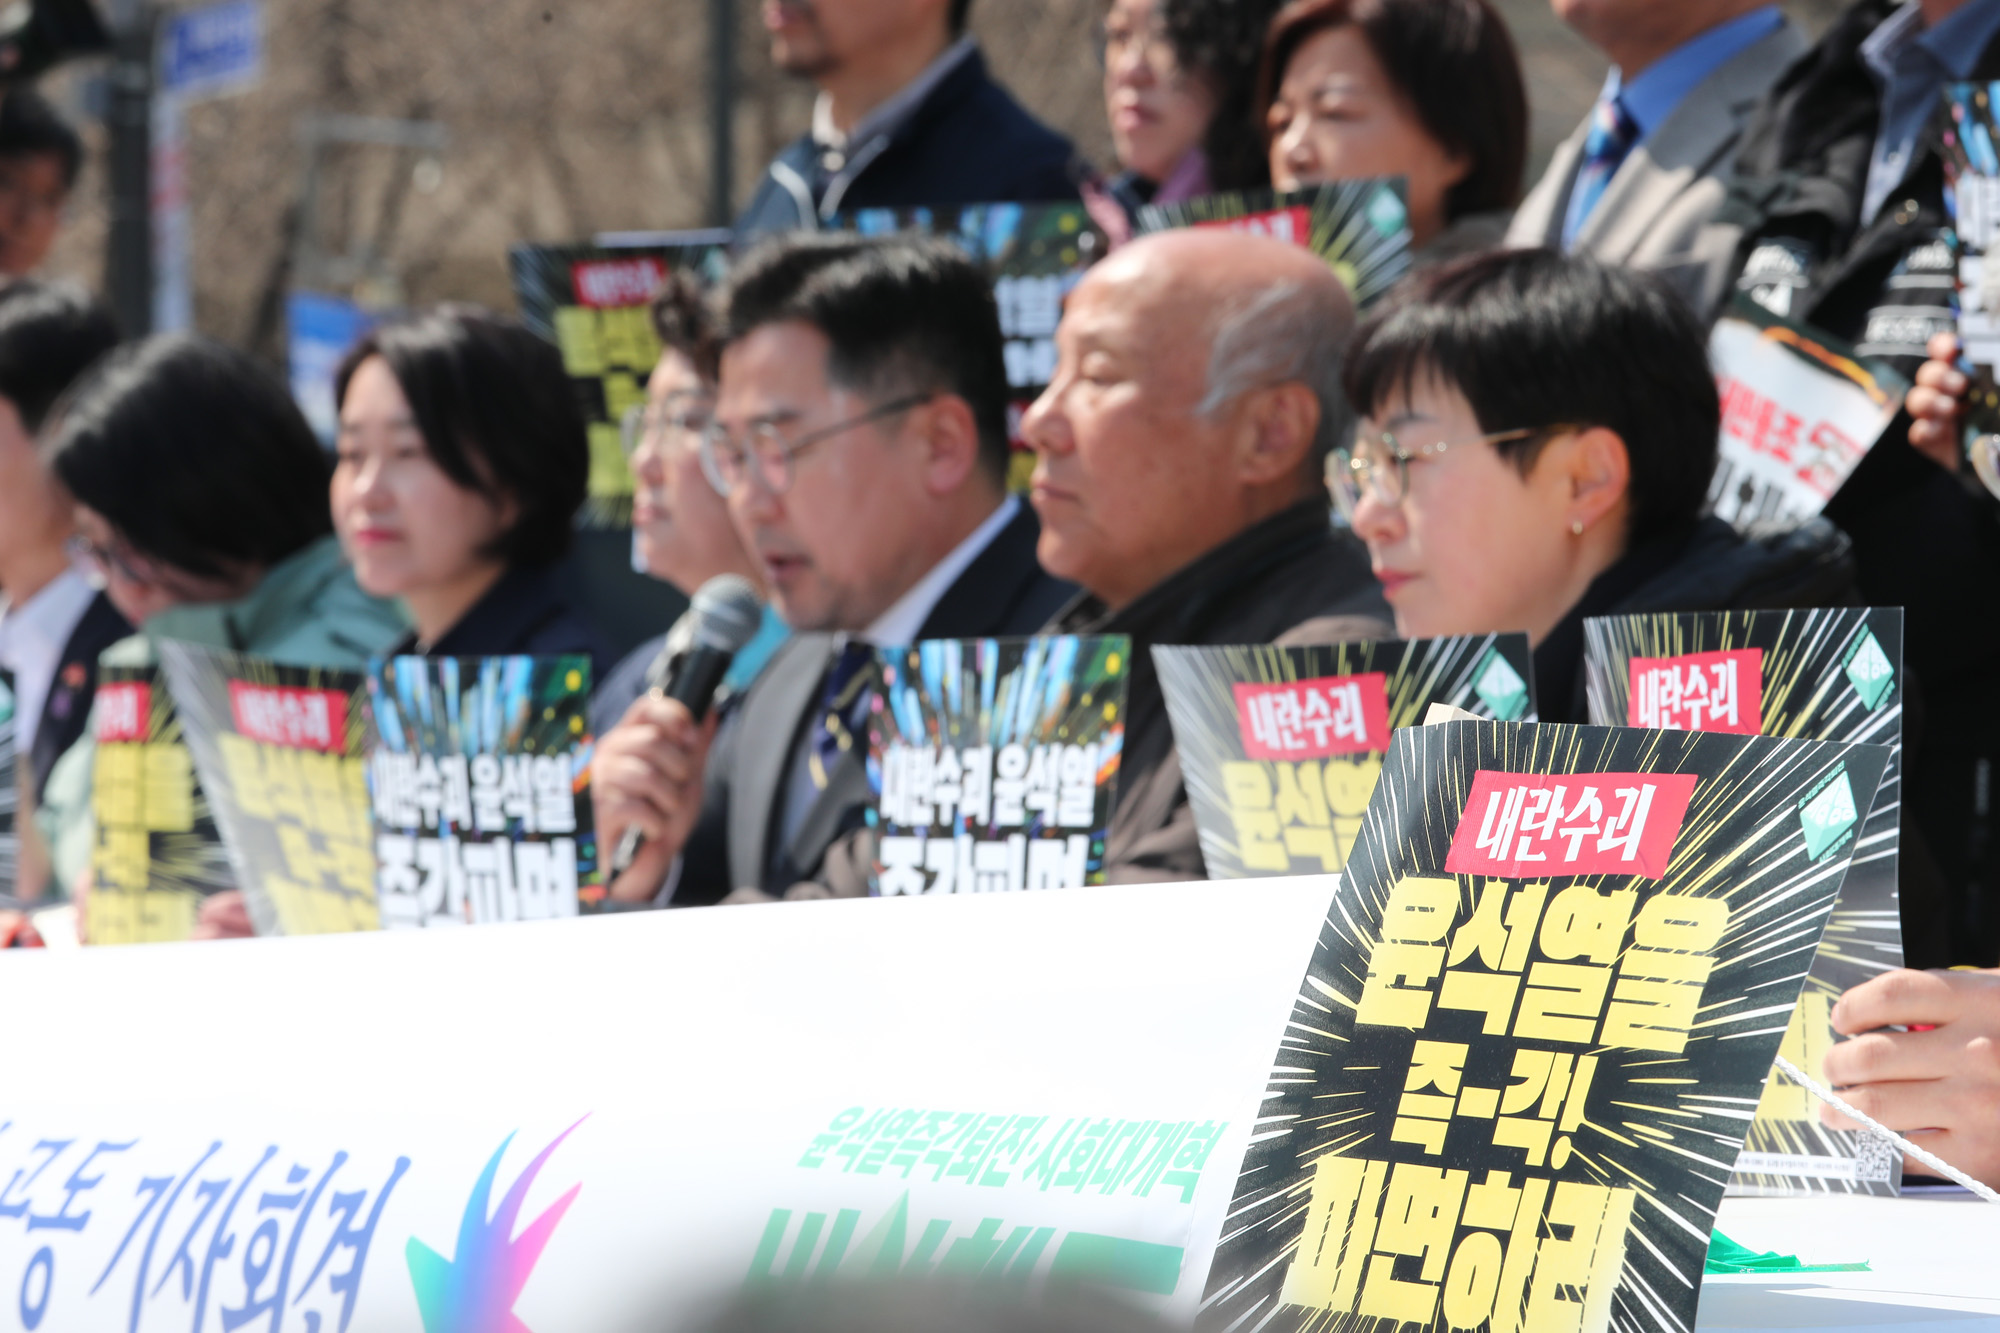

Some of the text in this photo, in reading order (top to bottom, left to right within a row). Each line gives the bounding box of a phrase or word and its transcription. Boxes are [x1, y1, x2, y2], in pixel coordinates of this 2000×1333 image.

[1248, 681, 1367, 750] 내란수괴
[1638, 658, 1739, 732] 내란수괴
[470, 751, 577, 833] 윤석열
[993, 742, 1101, 828] 윤석열
[1475, 783, 1657, 863] 내란수괴
[1355, 877, 1731, 1054] 윤석열을
[1390, 1040, 1598, 1170] 즉각!
[1279, 1154, 1637, 1333] 파면하라
